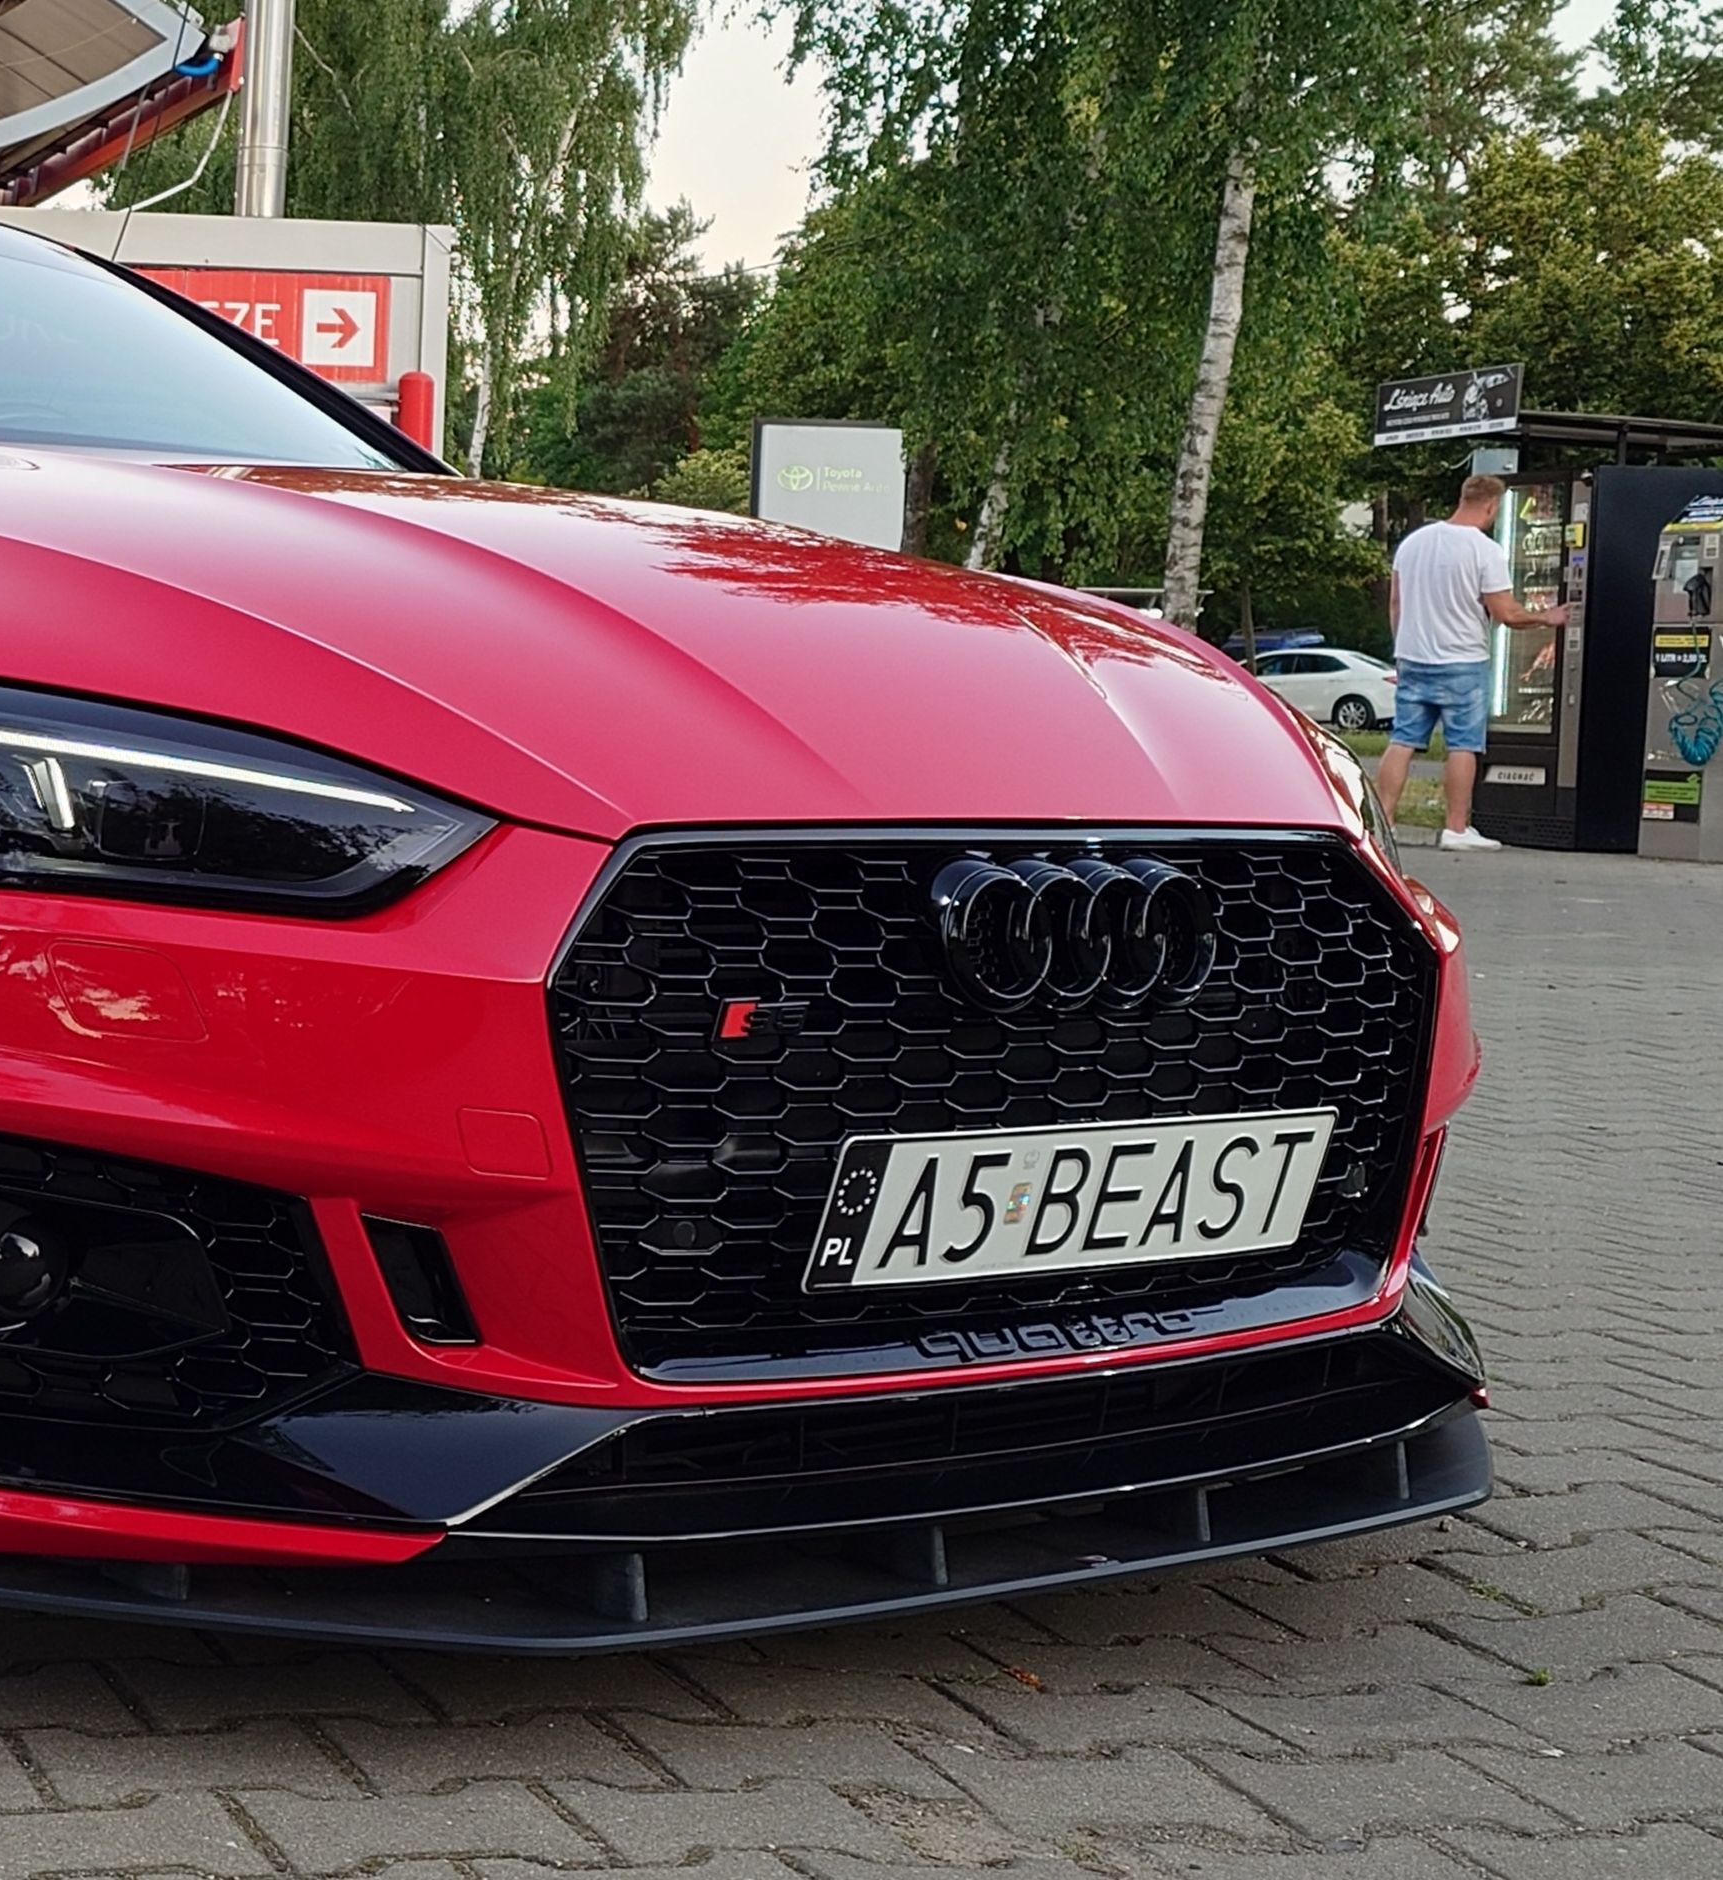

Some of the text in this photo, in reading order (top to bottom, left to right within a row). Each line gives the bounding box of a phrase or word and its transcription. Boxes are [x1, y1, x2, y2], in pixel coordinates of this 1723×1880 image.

[823, 466, 862, 481] Toyota
[874, 1130, 1316, 1270] A5 BEAST
[820, 1238, 854, 1267] PL
[919, 1308, 1198, 1363] quattro
